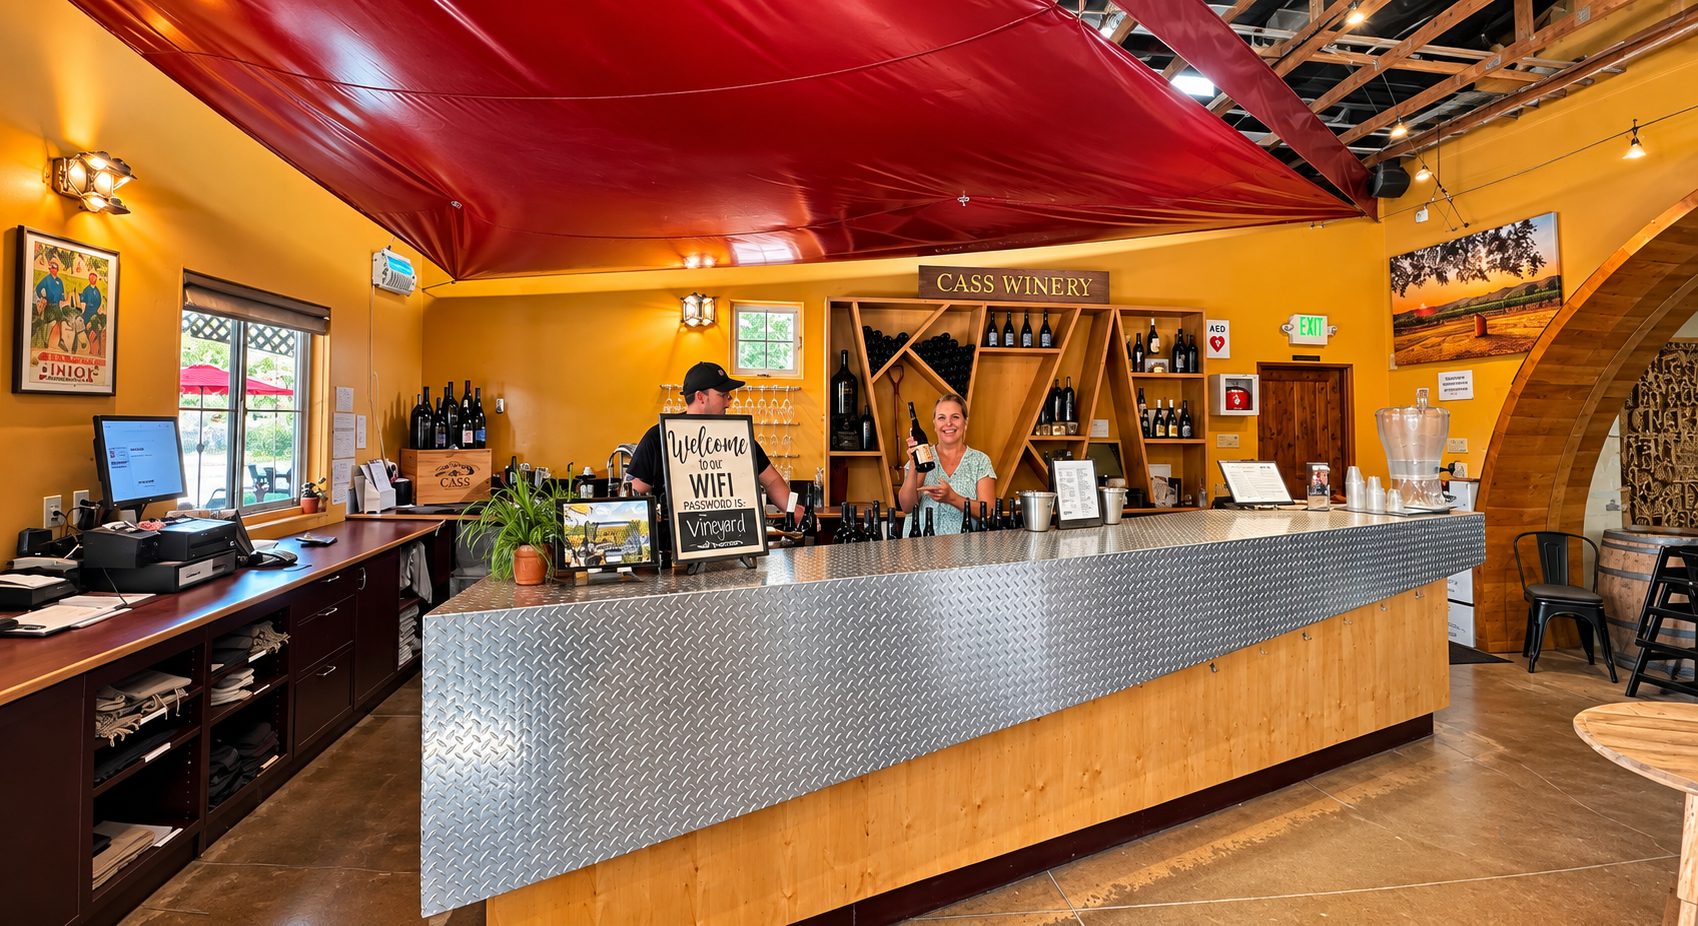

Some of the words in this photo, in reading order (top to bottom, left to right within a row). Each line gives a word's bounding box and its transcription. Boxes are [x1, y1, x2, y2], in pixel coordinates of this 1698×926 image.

[936, 273, 994, 294] CASS
[1002, 275, 1093, 297] WINERY
[1209, 325, 1226, 333] AED
[1299, 316, 1323, 337] EXIT
[668, 426, 748, 464] Welcome
[698, 459, 708, 471] to
[709, 460, 723, 470] our
[440, 477, 471, 488] CASS
[689, 473, 734, 499] WIFI
[683, 499, 732, 510] PASSWORD
[734, 498, 746, 508] IS:
[686, 512, 746, 541] Vineyard
